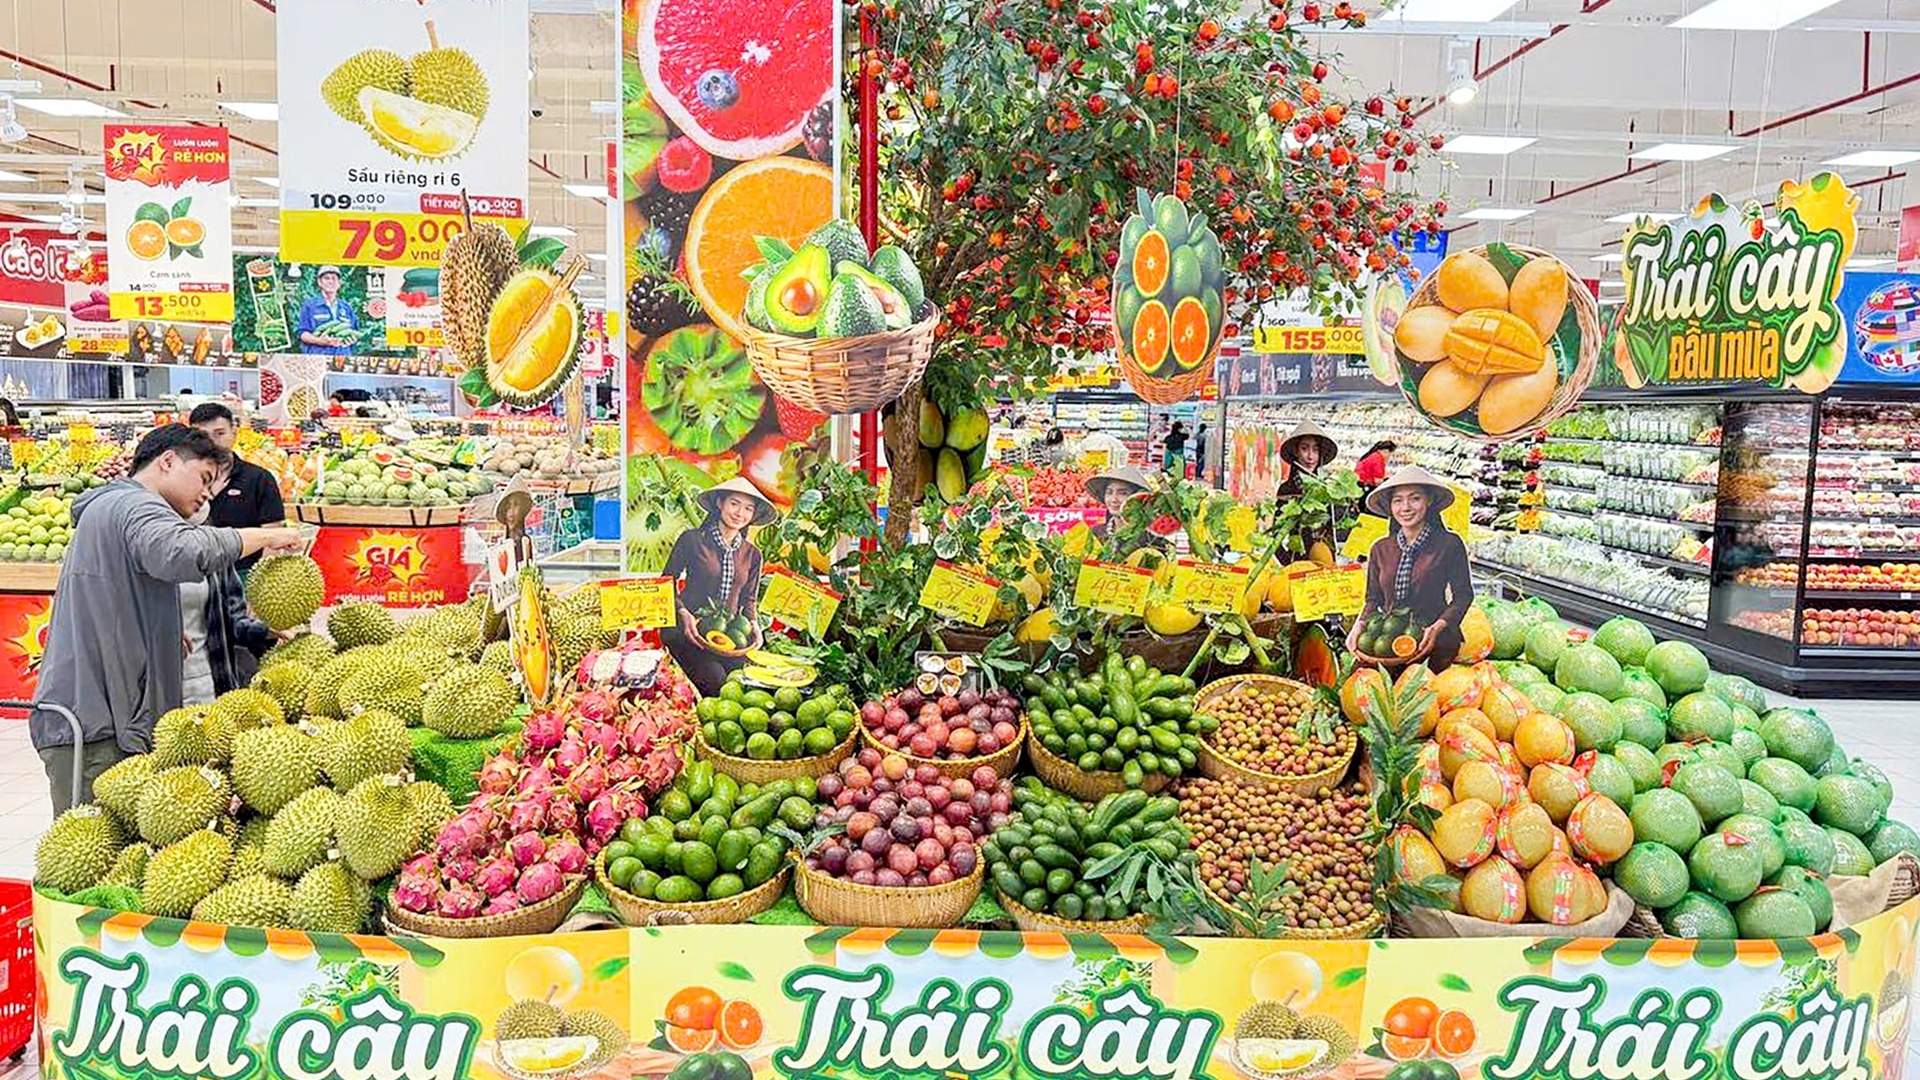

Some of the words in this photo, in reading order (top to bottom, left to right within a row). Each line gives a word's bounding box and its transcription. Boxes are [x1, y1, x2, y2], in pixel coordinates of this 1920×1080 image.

[119, 142, 154, 162] GIÁ
[173, 139, 195, 147] LUÔN
[196, 139, 219, 148] LUÔN
[173, 148, 193, 163] RẺ
[194, 151, 226, 163] HƠN
[384, 169, 428, 188] riêng
[450, 172, 461, 187] 6
[338, 218, 463, 262] 79.00
[1624, 235, 1717, 326] Trái
[1728, 221, 1835, 364] cây
[134, 295, 201, 316] 13.500
[405, 330, 443, 344] 10.80
[1281, 330, 1363, 351] 155.000
[365, 546, 412, 570] GIÁ
[387, 587, 408, 603] RẺ
[410, 589, 445, 603] HƠN
[60, 956, 252, 1078] Trái
[278, 998, 478, 1080] cây
[779, 971, 1002, 1074] Trái
[1030, 991, 1214, 1080] cây
[1490, 982, 1711, 1080] Trái
[1729, 998, 1868, 1080] cây
